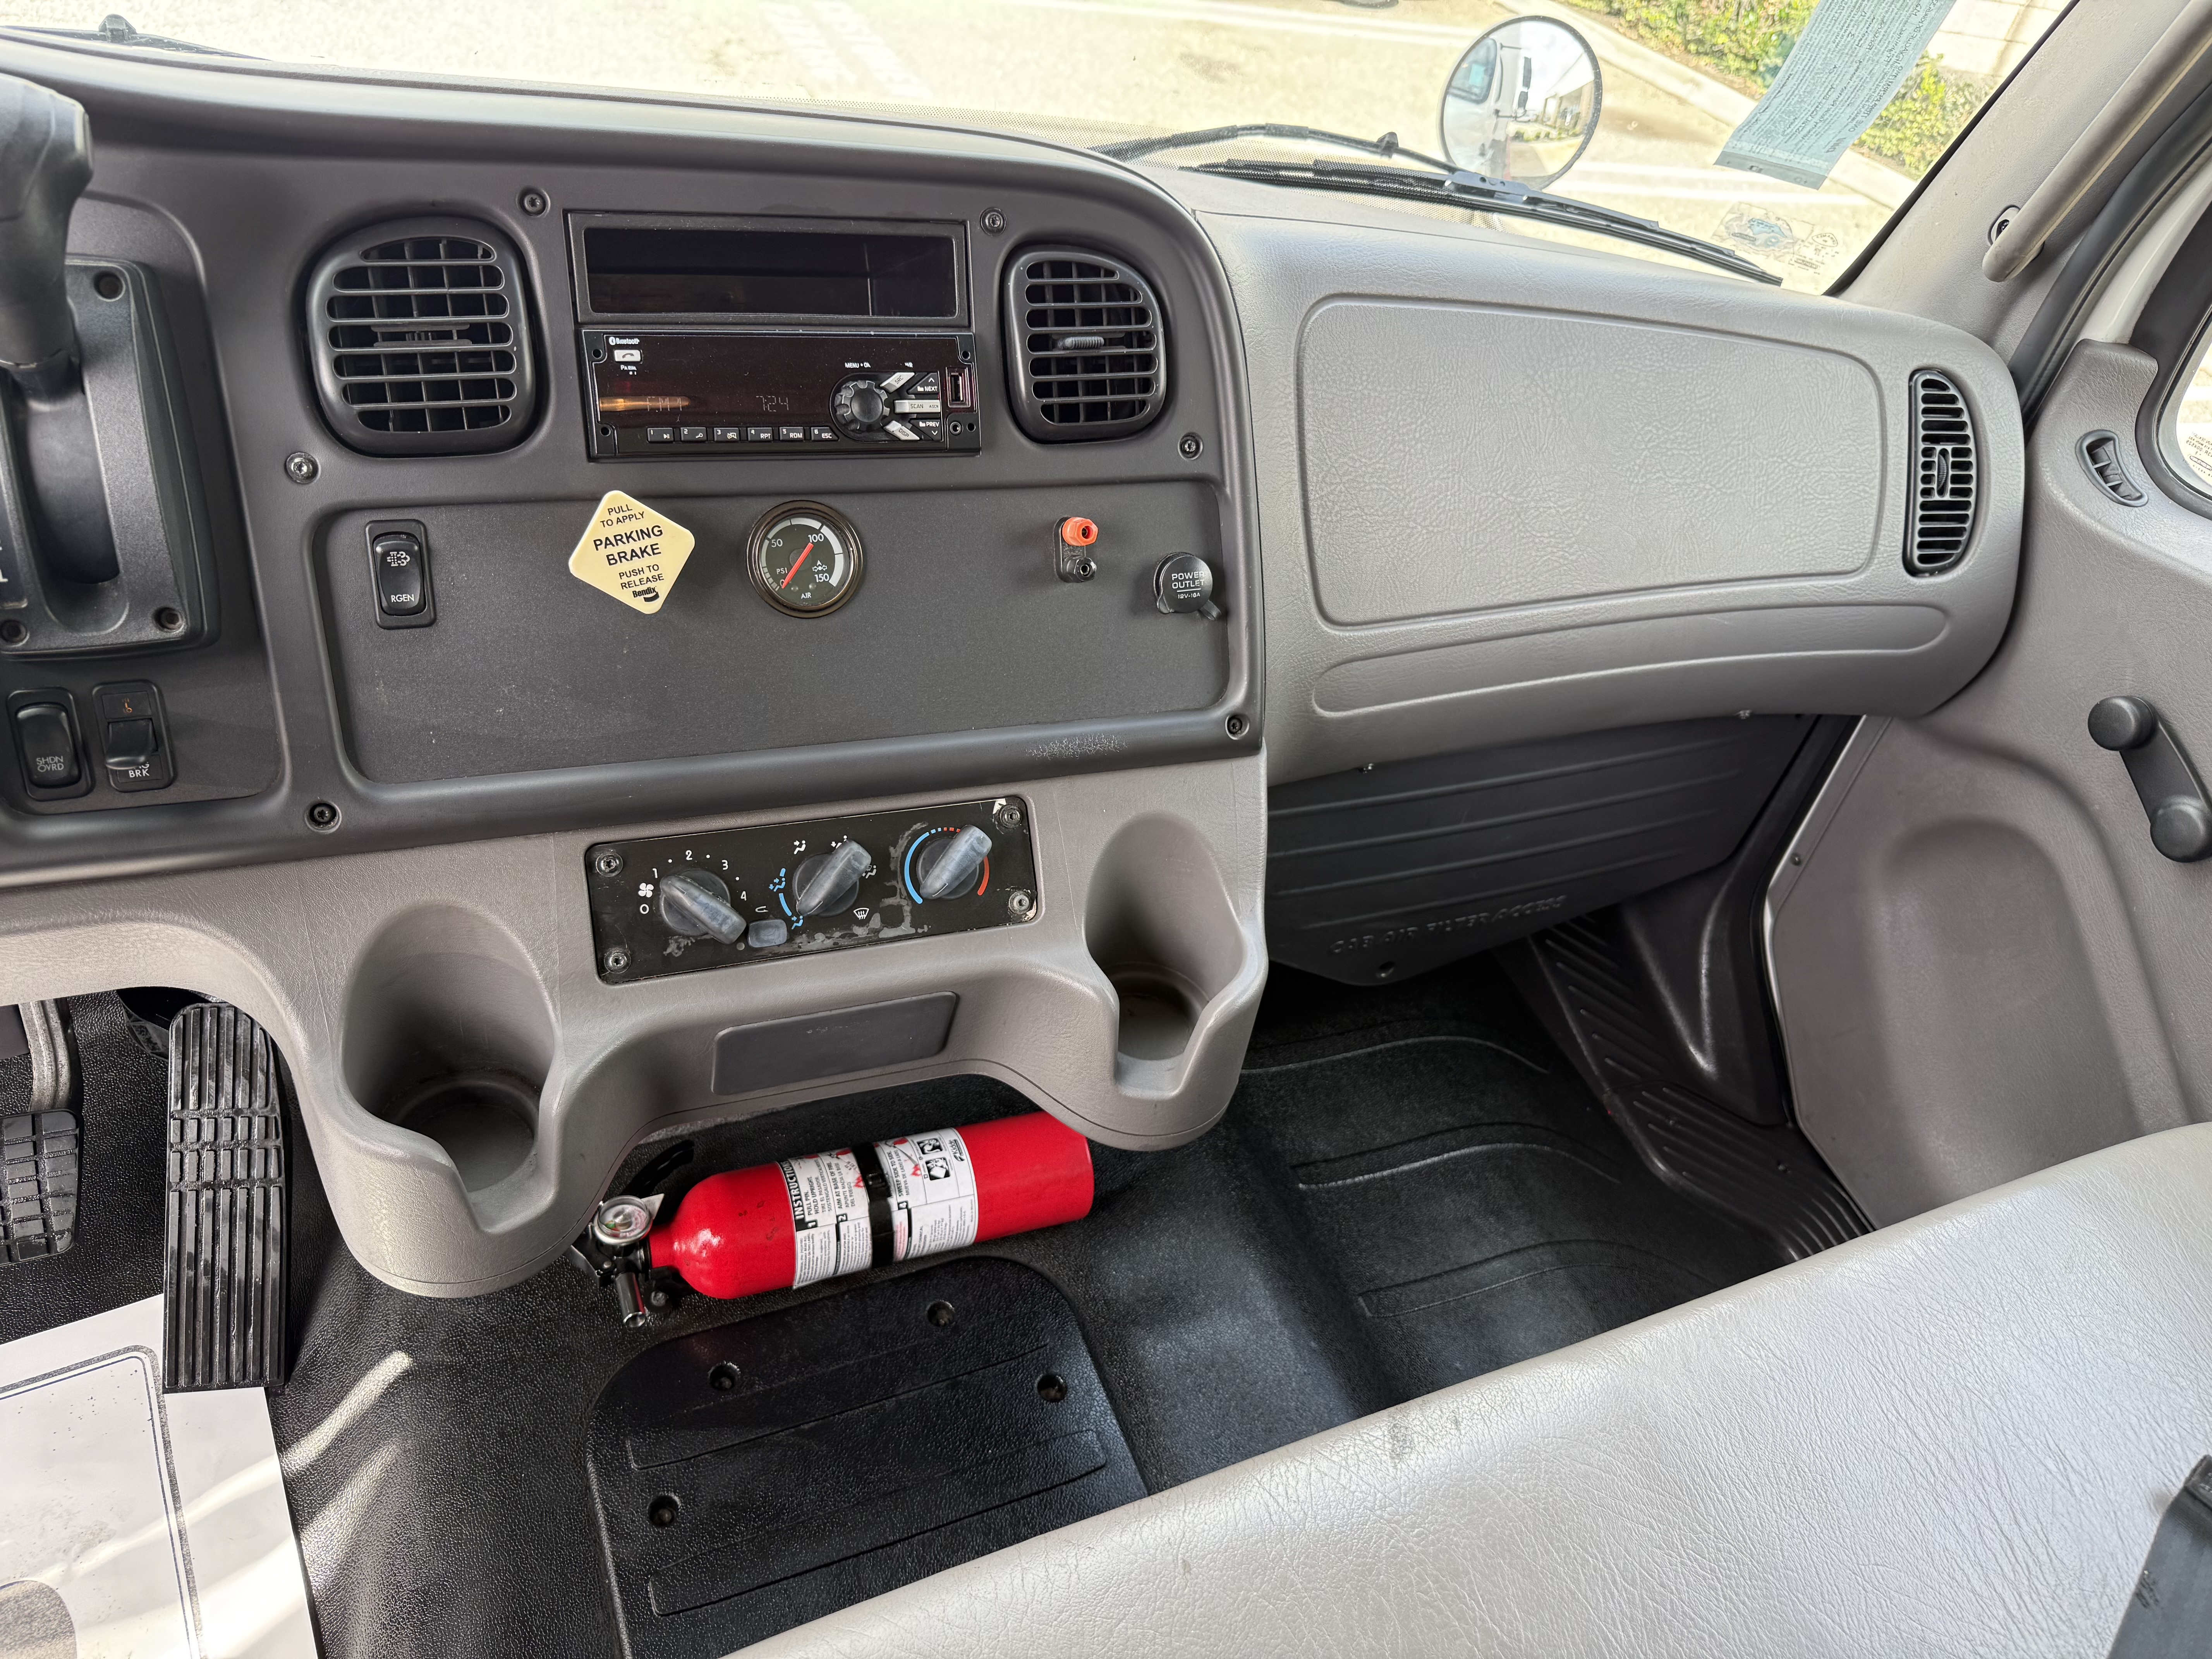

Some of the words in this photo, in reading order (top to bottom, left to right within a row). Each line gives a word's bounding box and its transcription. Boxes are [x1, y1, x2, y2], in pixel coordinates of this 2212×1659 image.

[895, 376, 903, 385] SRC
[898, 428, 909, 437] DISP
[608, 504, 633, 515] PULL
[600, 519, 613, 528] TO
[616, 511, 644, 525] APPLY
[593, 525, 663, 551] PARKING
[808, 533, 824, 543] 100
[771, 539, 783, 548] 50
[606, 543, 661, 566] BRAKE
[619, 567, 644, 579] PUSH
[646, 564, 659, 573] TO
[1172, 571, 1204, 580] POWER
[620, 574, 664, 590] RELEASE
[814, 573, 830, 582] 150
[1172, 580, 1205, 589] OUTLET
[632, 587, 657, 598] Bendix
[390, 594, 414, 603] RGEN
[36, 756, 64, 765] SHDN
[37, 763, 64, 772] OVRD
[129, 769, 149, 778] BRK
[685, 850, 693, 860] 2
[722, 860, 729, 870] 3
[653, 869, 658, 878] 1
[740, 891, 747, 901] 4
[640, 904, 649, 915] 0
[807, 1176, 816, 1197] UPRIGHT.
